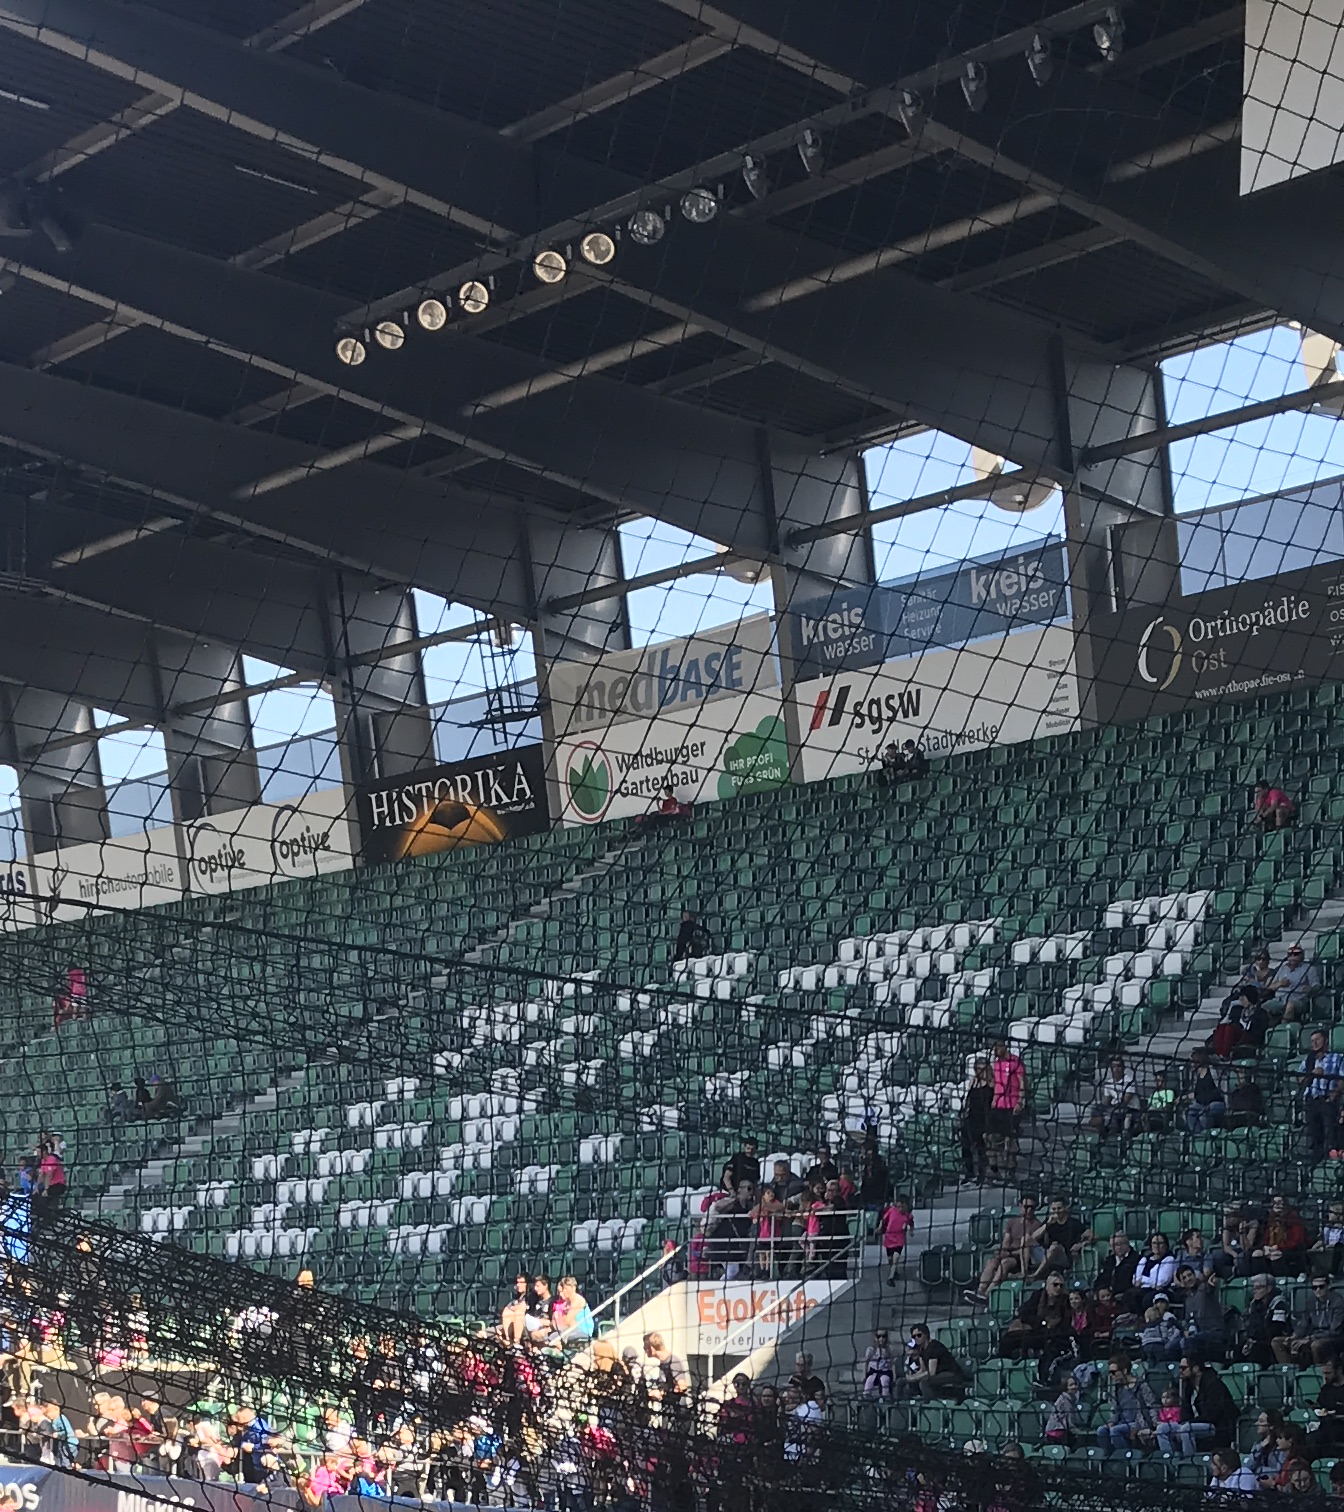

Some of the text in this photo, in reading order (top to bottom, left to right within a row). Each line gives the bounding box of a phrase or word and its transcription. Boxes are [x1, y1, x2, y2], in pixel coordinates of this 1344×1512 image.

[970, 556, 1045, 603] kreis
[996, 586, 1056, 617] wasser
[1189, 595, 1310, 642] Orthopädie
[800, 602, 866, 646] kreis
[823, 633, 876, 660] wasser
[1192, 648, 1228, 673] Ost
[852, 688, 921, 735] sgsw
[918, 722, 998, 752] Stadtwerke
[616, 740, 706, 773] Waldburger
[729, 758, 744, 771] IHR
[368, 761, 532, 830] HISTORIKA
[618, 768, 699, 798] Gartenbau
[197, 846, 247, 884] optive
[279, 826, 331, 869] optive
[79, 864, 174, 899] hirschautomobile
[698, 1290, 819, 1331] EgoKiefe
[759, 1335, 775, 1346] un
